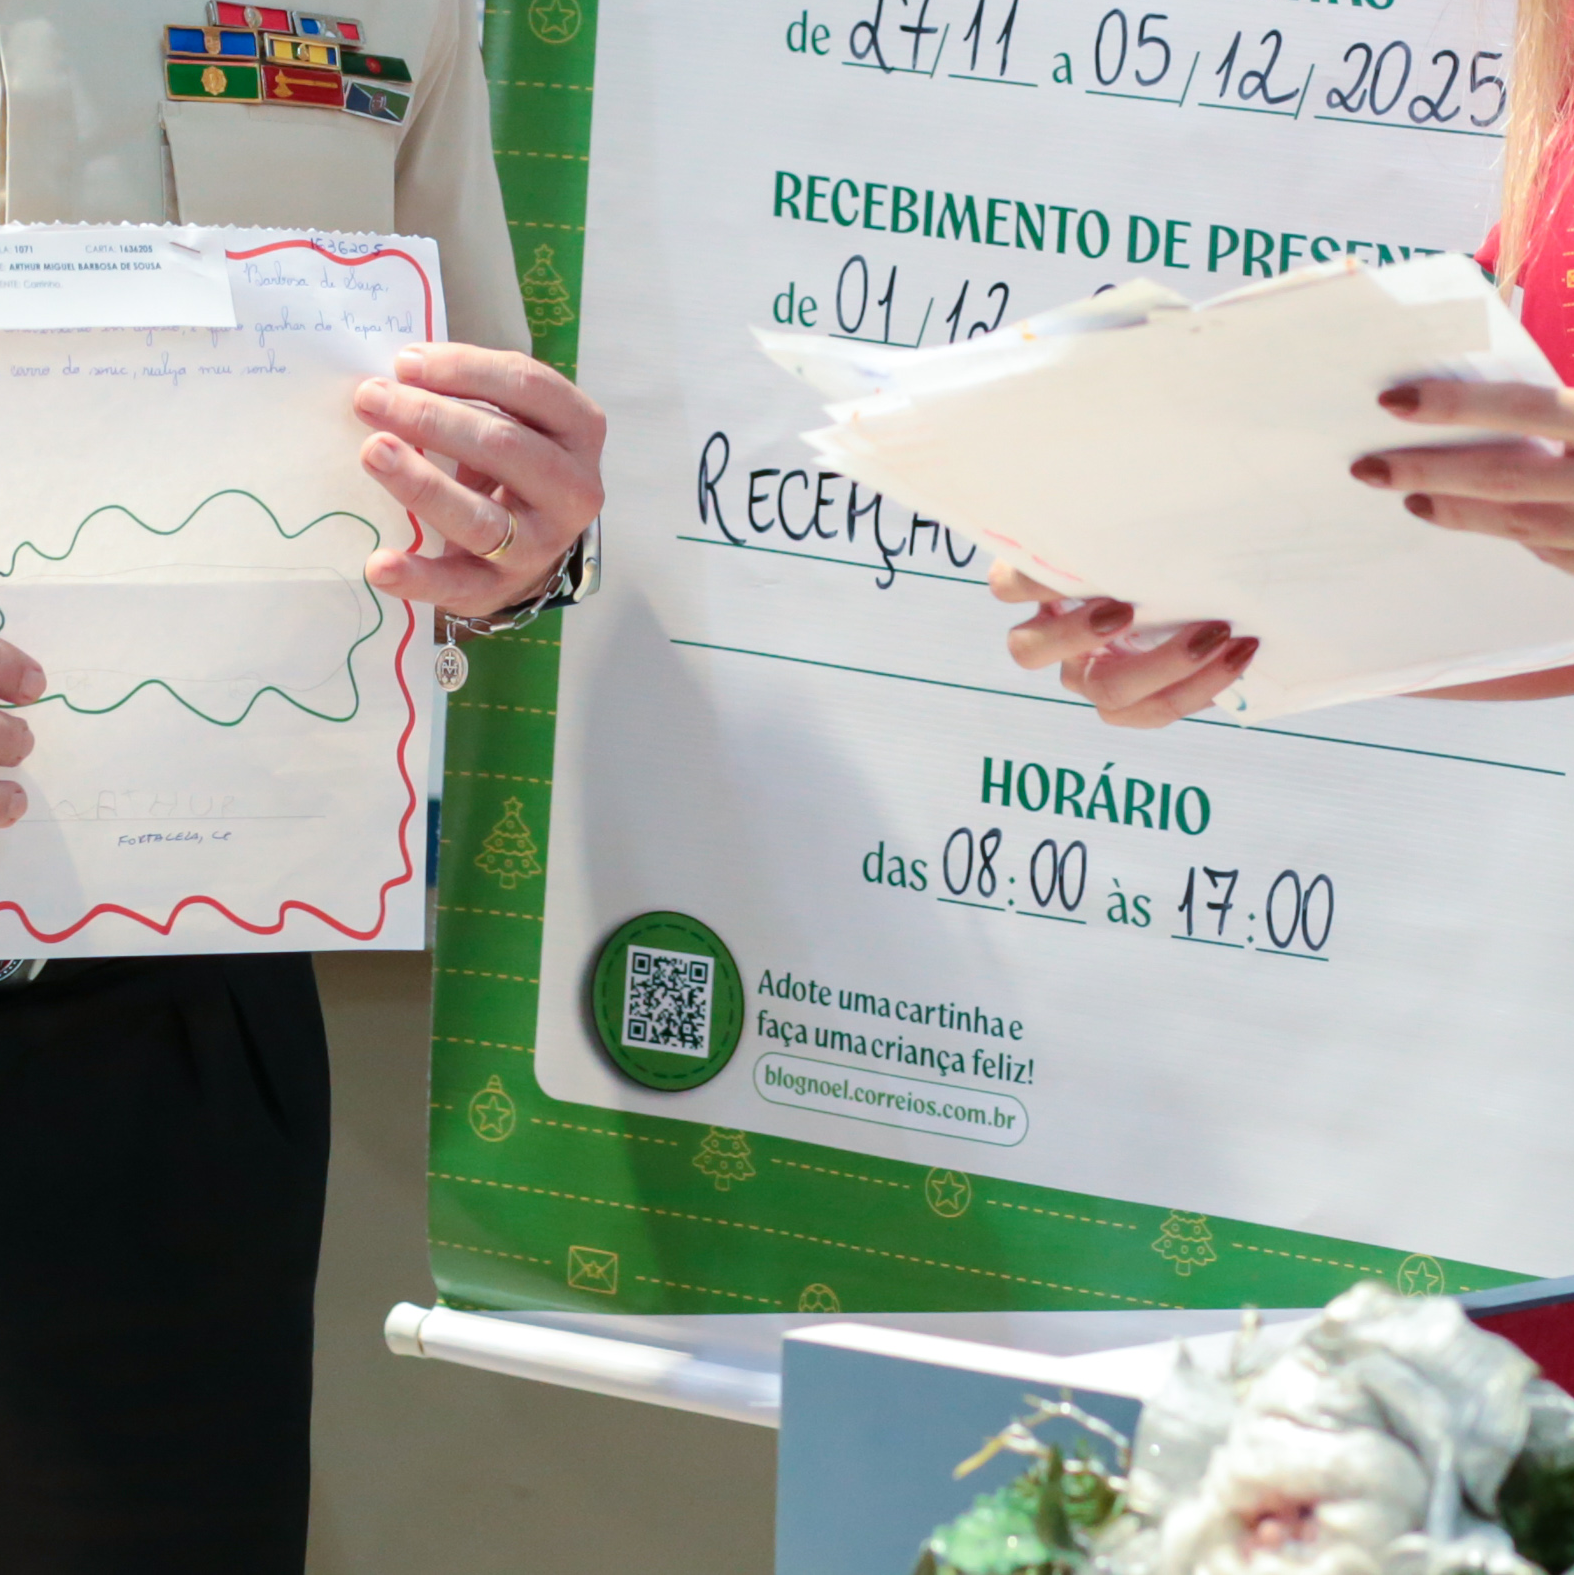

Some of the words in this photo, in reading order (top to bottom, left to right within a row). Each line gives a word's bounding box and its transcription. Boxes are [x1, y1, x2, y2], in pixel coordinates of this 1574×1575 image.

[786, 9, 831, 58] de
[1052, 52, 1073, 86] a
[773, 169, 1111, 259] RECEBIMENTO
[1127, 215, 1192, 270] DE
[9, 262, 41, 271] ARTHUR
[43, 262, 76, 271] MIGUEL
[78, 262, 118, 271] BARBOSA
[120, 262, 131, 271] DE
[133, 262, 162, 271] SOUSA
[773, 282, 818, 328] de
[981, 755, 1212, 835] HORÁRIO
[862, 841, 928, 892] das
[1106, 877, 1153, 929] às
[757, 969, 832, 1006] Adote
[838, 989, 891, 1019] uma
[895, 1001, 1004, 1038] cartinha
[1008, 1019, 1024, 1041] e
[757, 1010, 808, 1047] faça
[815, 1026, 867, 1056] uma
[871, 1035, 965, 1077] criança
[972, 1048, 1035, 1085] feliz!
[764, 1065, 1016, 1129] blognoel.correios.com.br
